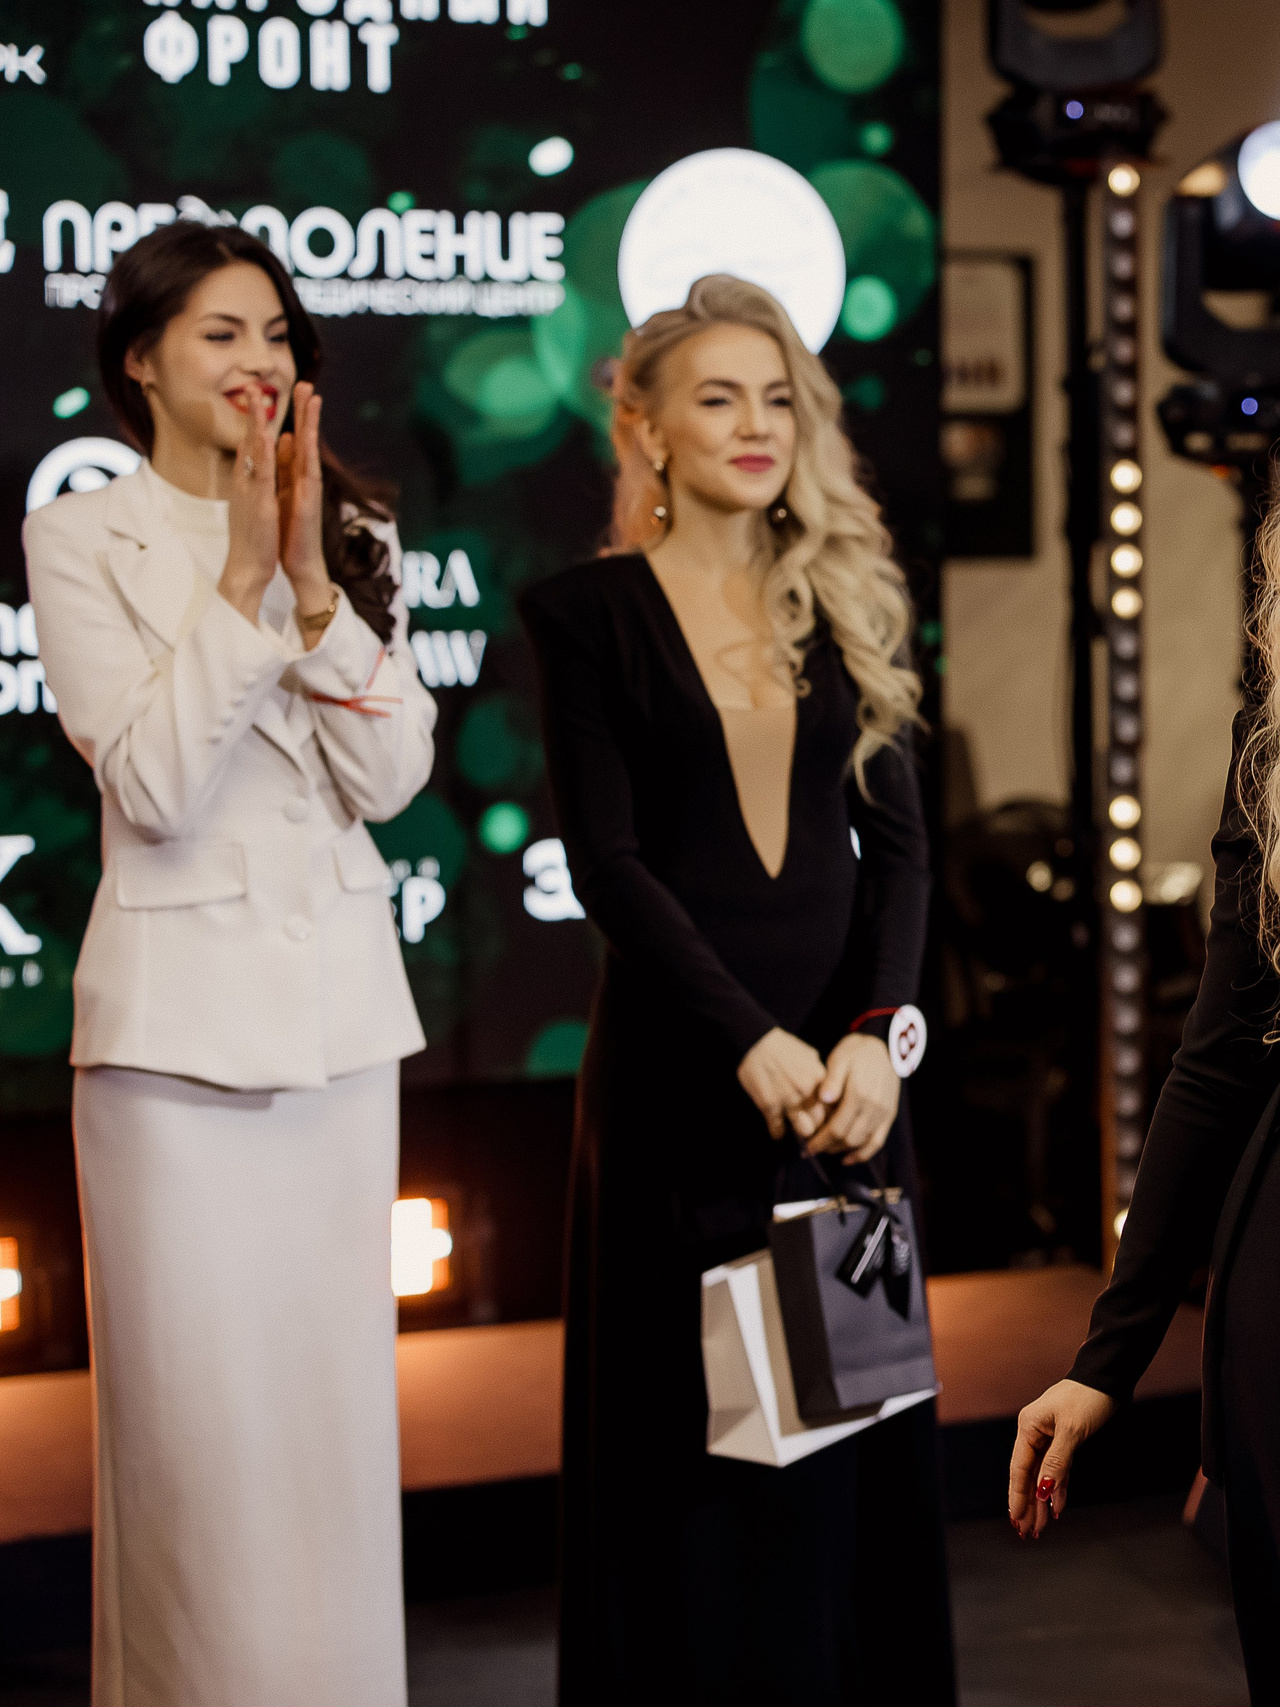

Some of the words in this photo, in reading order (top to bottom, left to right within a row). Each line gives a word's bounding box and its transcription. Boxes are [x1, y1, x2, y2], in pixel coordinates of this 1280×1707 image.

[143, 10, 400, 93] ФРОНТ
[43, 200, 566, 282] ПРОЛЕНИЕ
[898, 1022, 917, 1060] 8
